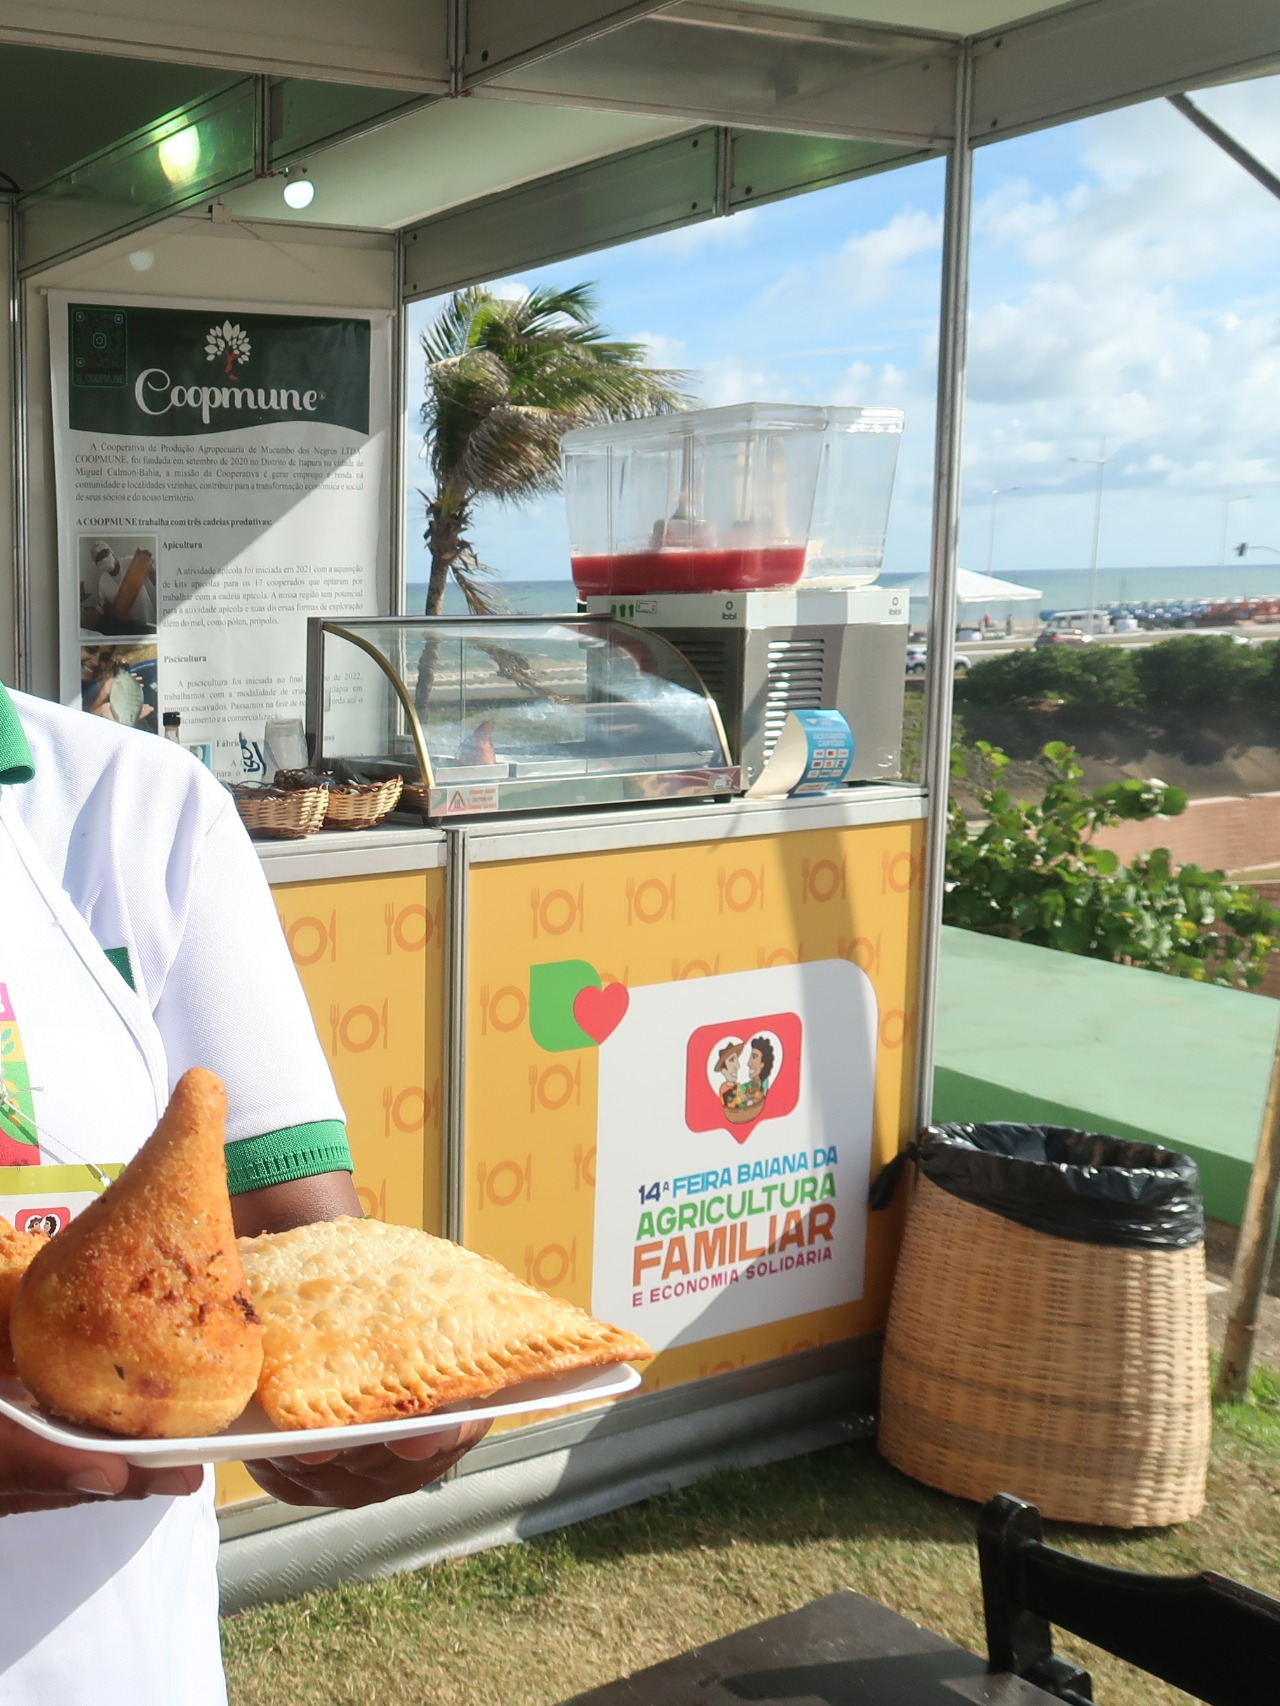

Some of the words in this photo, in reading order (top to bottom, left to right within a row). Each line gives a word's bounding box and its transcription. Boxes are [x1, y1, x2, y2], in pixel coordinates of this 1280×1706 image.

[135, 368, 317, 424] Coopmune
[100, 443, 145, 454] Cooperativa
[148, 443, 157, 452] de
[161, 444, 194, 455] Produção
[198, 444, 244, 455] Agropecuária
[248, 445, 257, 453] de
[314, 446, 337, 457] Negros
[75, 455, 129, 466] COOPMUNE,
[131, 456, 141, 464] foi
[143, 456, 171, 464] fundada
[186, 456, 218, 465] setembro
[220, 457, 229, 465] de
[230, 457, 248, 465] 2020
[261, 457, 286, 466] Distrito
[288, 458, 296, 466] de
[75, 468, 103, 478] Miguel
[174, 469, 200, 477] missão
[203, 469, 212, 477] da
[216, 469, 260, 480] Cooperativa
[271, 472, 289, 480] gerar
[292, 472, 323, 481] emprego
[75, 480, 121, 489] comunidade
[127, 480, 166, 489] localidades
[199, 481, 233, 489] contribuir
[234, 483, 250, 492] para
[256, 481, 304, 492] transformação
[75, 493, 84, 501] de
[103, 493, 126, 501] sócios
[132, 493, 141, 501] do
[83, 517, 137, 526] COOPMUNE
[138, 517, 169, 526] trabalha
[187, 517, 202, 526] três
[203, 517, 230, 526] cadeias
[162, 541, 203, 551] Apicultura
[184, 566, 217, 575] atividade
[244, 565, 254, 574] foi
[255, 565, 282, 574] iniciada
[296, 565, 312, 573] 2021
[162, 580, 170, 588] de
[174, 580, 187, 588] kits
[224, 581, 238, 590] para
[254, 579, 263, 587] 17
[266, 578, 305, 589] cooperados
[308, 580, 320, 588] que
[352, 579, 363, 588] por
[218, 591, 241, 600] cadeia
[299, 590, 320, 601] região
[320, 590, 333, 598] tem
[184, 604, 217, 613] atividade
[267, 603, 295, 611] diversas
[296, 602, 318, 611] formas
[320, 602, 327, 610] de
[180, 618, 190, 626] do
[163, 654, 207, 663] Piscicultura
[187, 677, 228, 689] piscicultura
[232, 677, 242, 685] foi
[245, 675, 273, 684] iniciada
[163, 691, 205, 701] trabalhamos
[236, 688, 276, 697] modalidade
[280, 687, 288, 695] de
[230, 700, 264, 709] Passamos
[275, 699, 289, 707] fase
[290, 698, 298, 707] de
[672, 1168, 732, 1198] FEIRA
[737, 1151, 808, 1184] BAIANA
[813, 1145, 839, 1168] DA
[636, 1172, 836, 1241] AGRICULTURA
[632, 1203, 837, 1287] FAMILIAR
[632, 1292, 643, 1307] E
[650, 1269, 740, 1303] ECONOMIA
